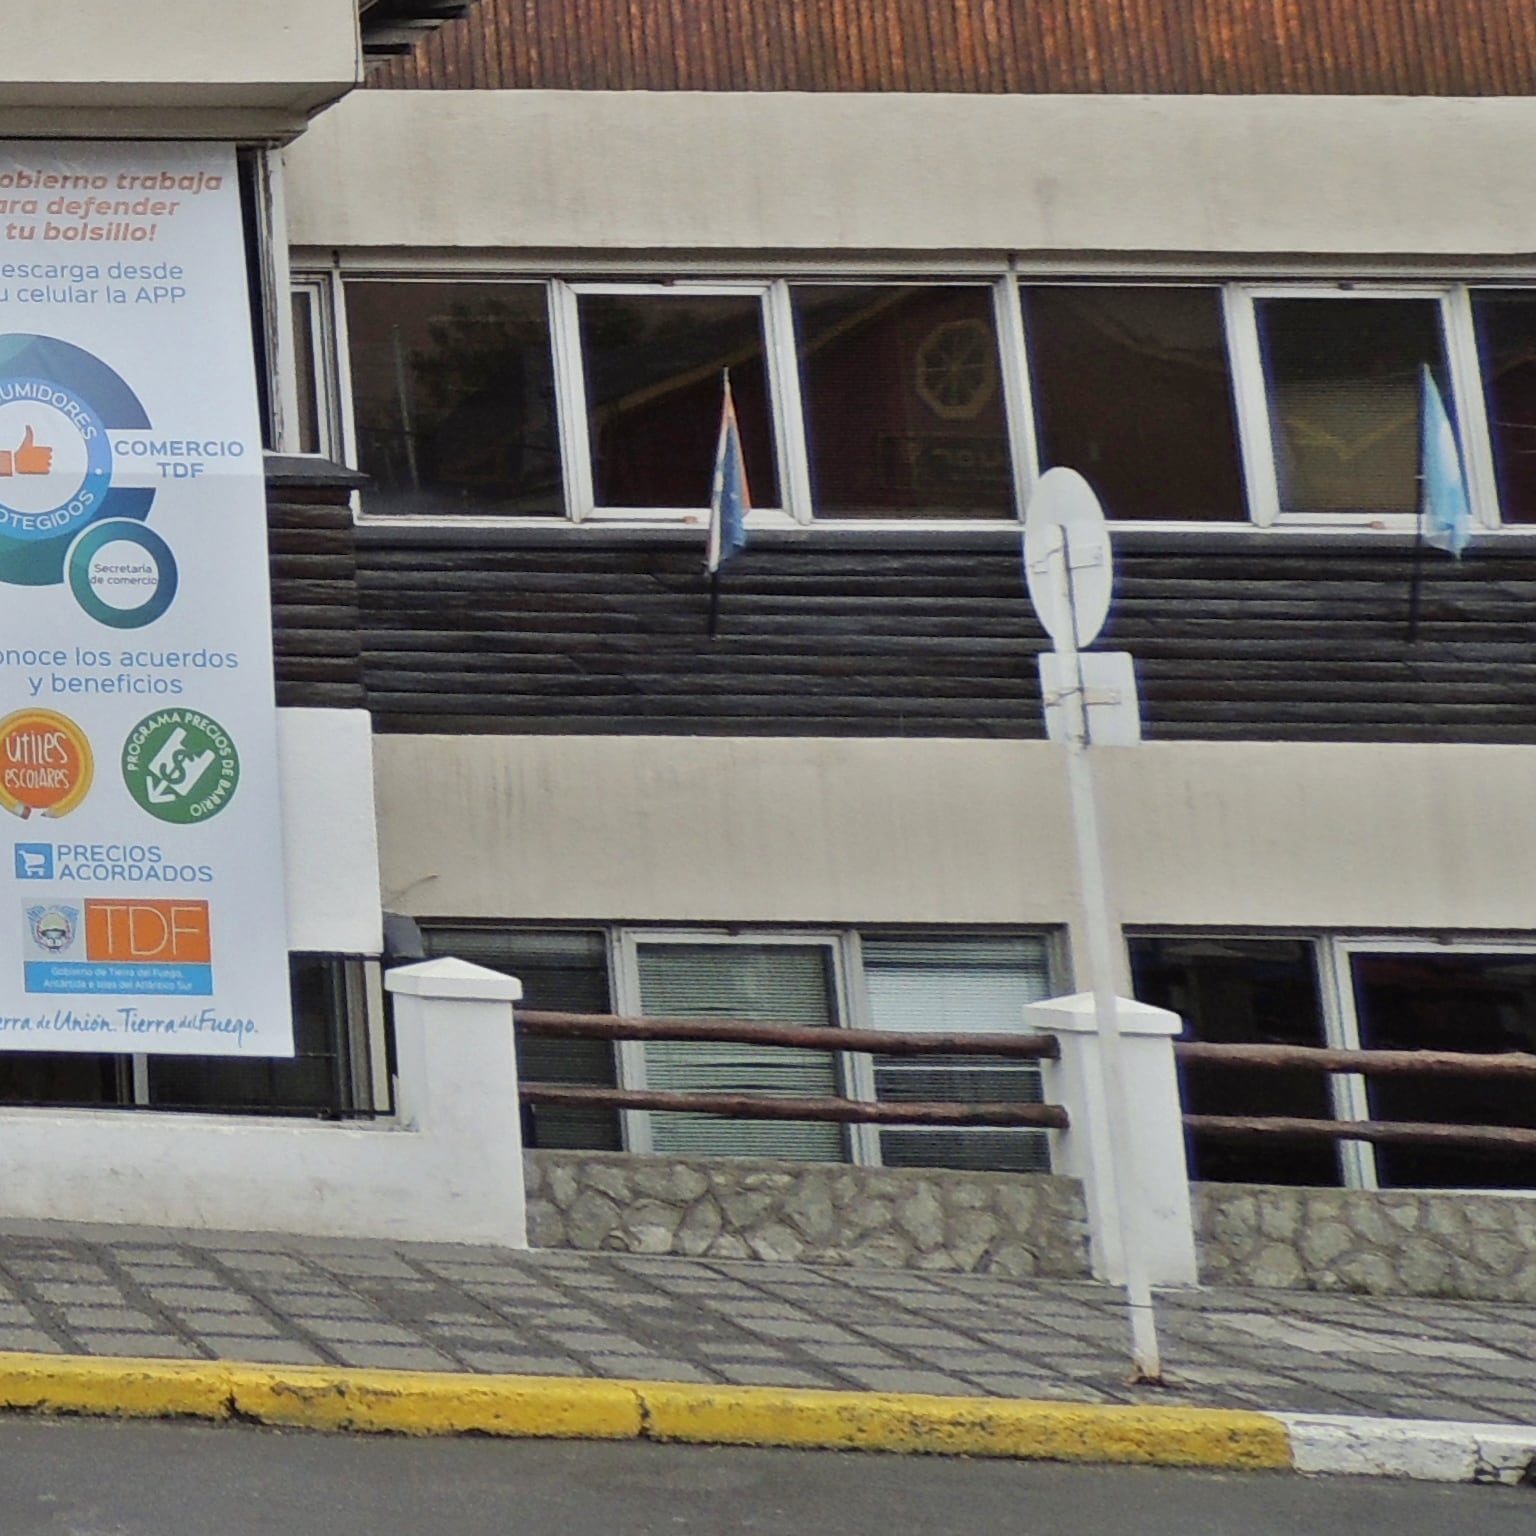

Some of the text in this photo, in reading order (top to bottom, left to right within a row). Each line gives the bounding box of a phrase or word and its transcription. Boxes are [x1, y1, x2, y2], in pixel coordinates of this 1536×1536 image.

[117, 173, 223, 194] trabaja
[46, 197, 180, 218] defender
[6, 223, 157, 242] tu bolsillo!
[107, 261, 183, 280] desde
[17, 285, 98, 303] celular
[107, 286, 126, 303] la
[135, 287, 186, 303] APP
[115, 441, 244, 457] COMERCIO
[157, 463, 204, 478] TDF
[90, 575, 158, 586] de comercio
[76, 647, 111, 668] los
[120, 649, 238, 669] acuerdos
[28, 673, 183, 696] y beneficios
[127, 712, 234, 816] PROGRAMA PRECIOS DE BARRIO
[57, 844, 161, 862] PRECIOS
[59, 864, 213, 882] ACORDADOS
[89, 905, 202, 955] TDF
[37, 1015, 50, 1029] de
[118, 1008, 178, 1034] Tierra
[180, 1017, 198, 1030] del
